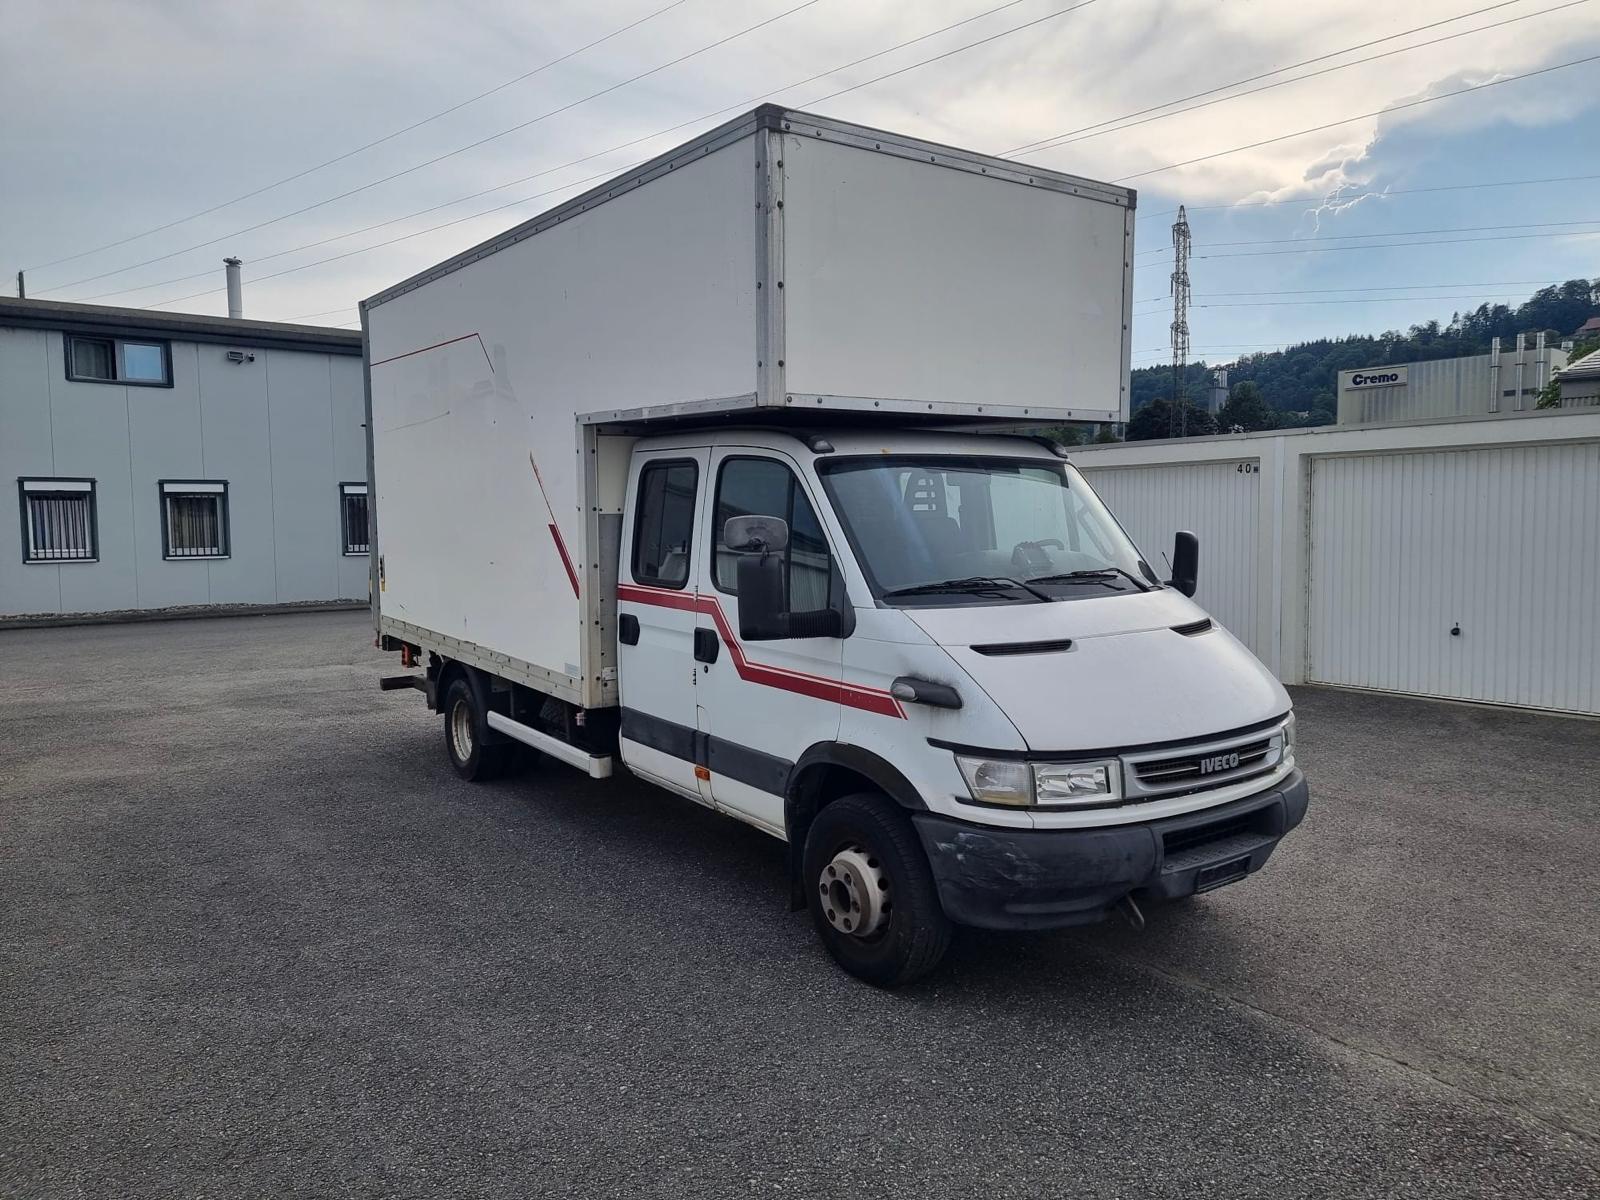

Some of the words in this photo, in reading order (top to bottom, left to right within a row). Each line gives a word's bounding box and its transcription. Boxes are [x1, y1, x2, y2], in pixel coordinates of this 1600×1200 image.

[1352, 373, 1399, 386] Cremo
[1237, 463, 1251, 474] 40
[1200, 752, 1239, 774] IVECO
